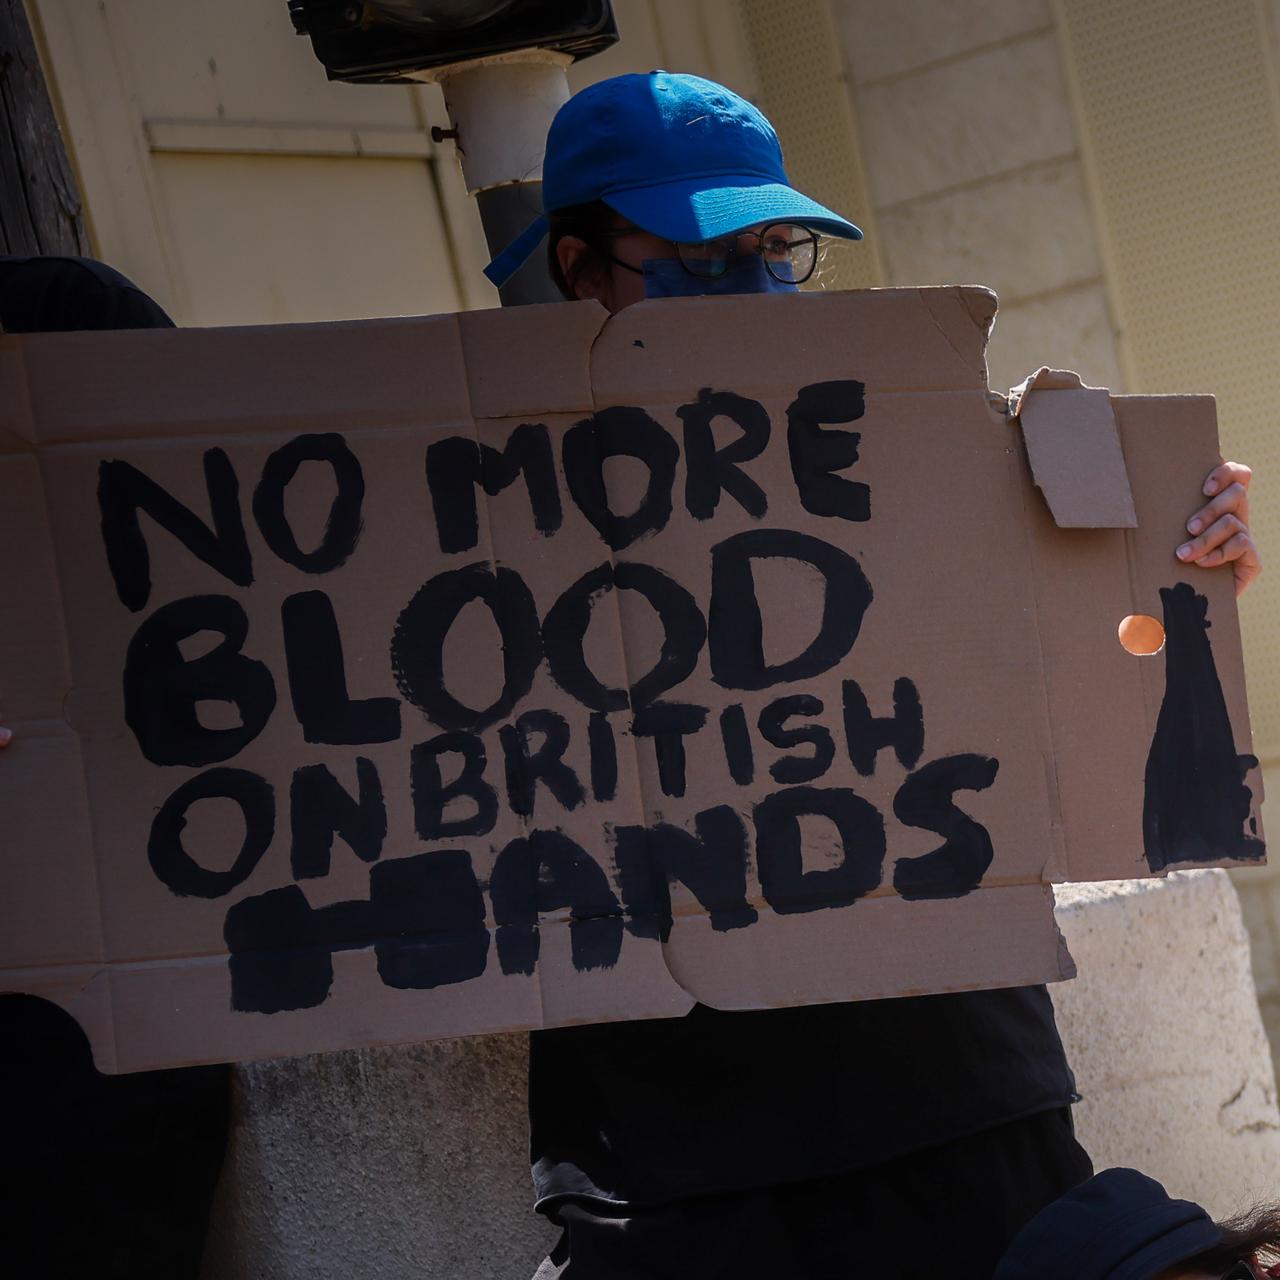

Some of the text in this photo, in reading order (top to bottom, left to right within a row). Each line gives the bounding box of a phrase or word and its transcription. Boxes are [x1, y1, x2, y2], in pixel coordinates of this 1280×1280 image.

[98, 378, 872, 613] NO MORE
[122, 528, 874, 768] BLOOD
[147, 676, 925, 900] ON BRITISH
[223, 752, 1001, 1015] HANDS
